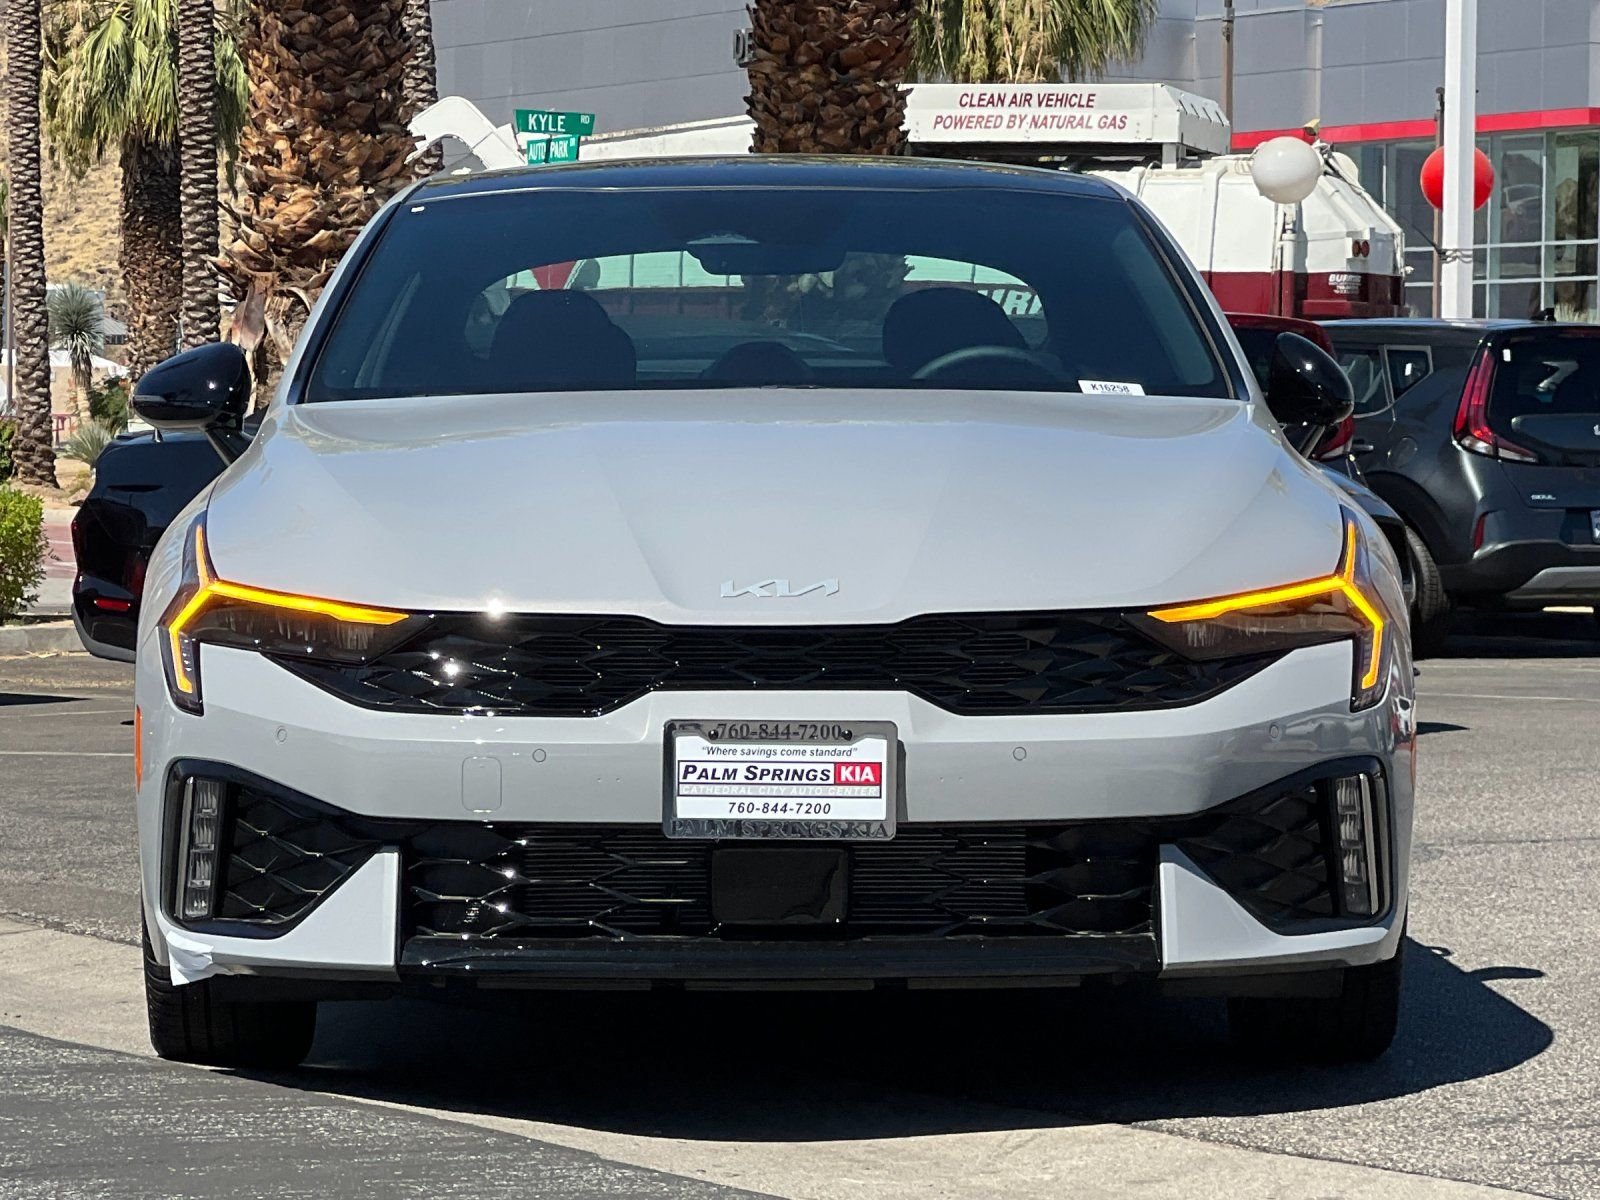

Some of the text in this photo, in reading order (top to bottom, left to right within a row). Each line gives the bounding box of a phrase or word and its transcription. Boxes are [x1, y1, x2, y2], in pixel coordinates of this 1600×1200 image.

[959, 93, 1096, 108] CLEAN AIR VEHICLE
[528, 113, 590, 132] KYLE RD
[933, 115, 1128, 130] POWERED BY NATURAL GAS
[528, 142, 546, 160] AUTO
[550, 141, 568, 159] PARK
[1090, 383, 1130, 393] K16258
[717, 723, 842, 741] 760-844-7200
[740, 747, 777, 759] savings
[780, 748, 807, 757] come
[682, 764, 875, 783] PALM SPRINGS KIA
[682, 785, 878, 797] CATHEDRAL CITY AUTO CENTER
[728, 802, 831, 815] 760-844-7200
[671, 819, 889, 838] PALM SPRINGS KIA
